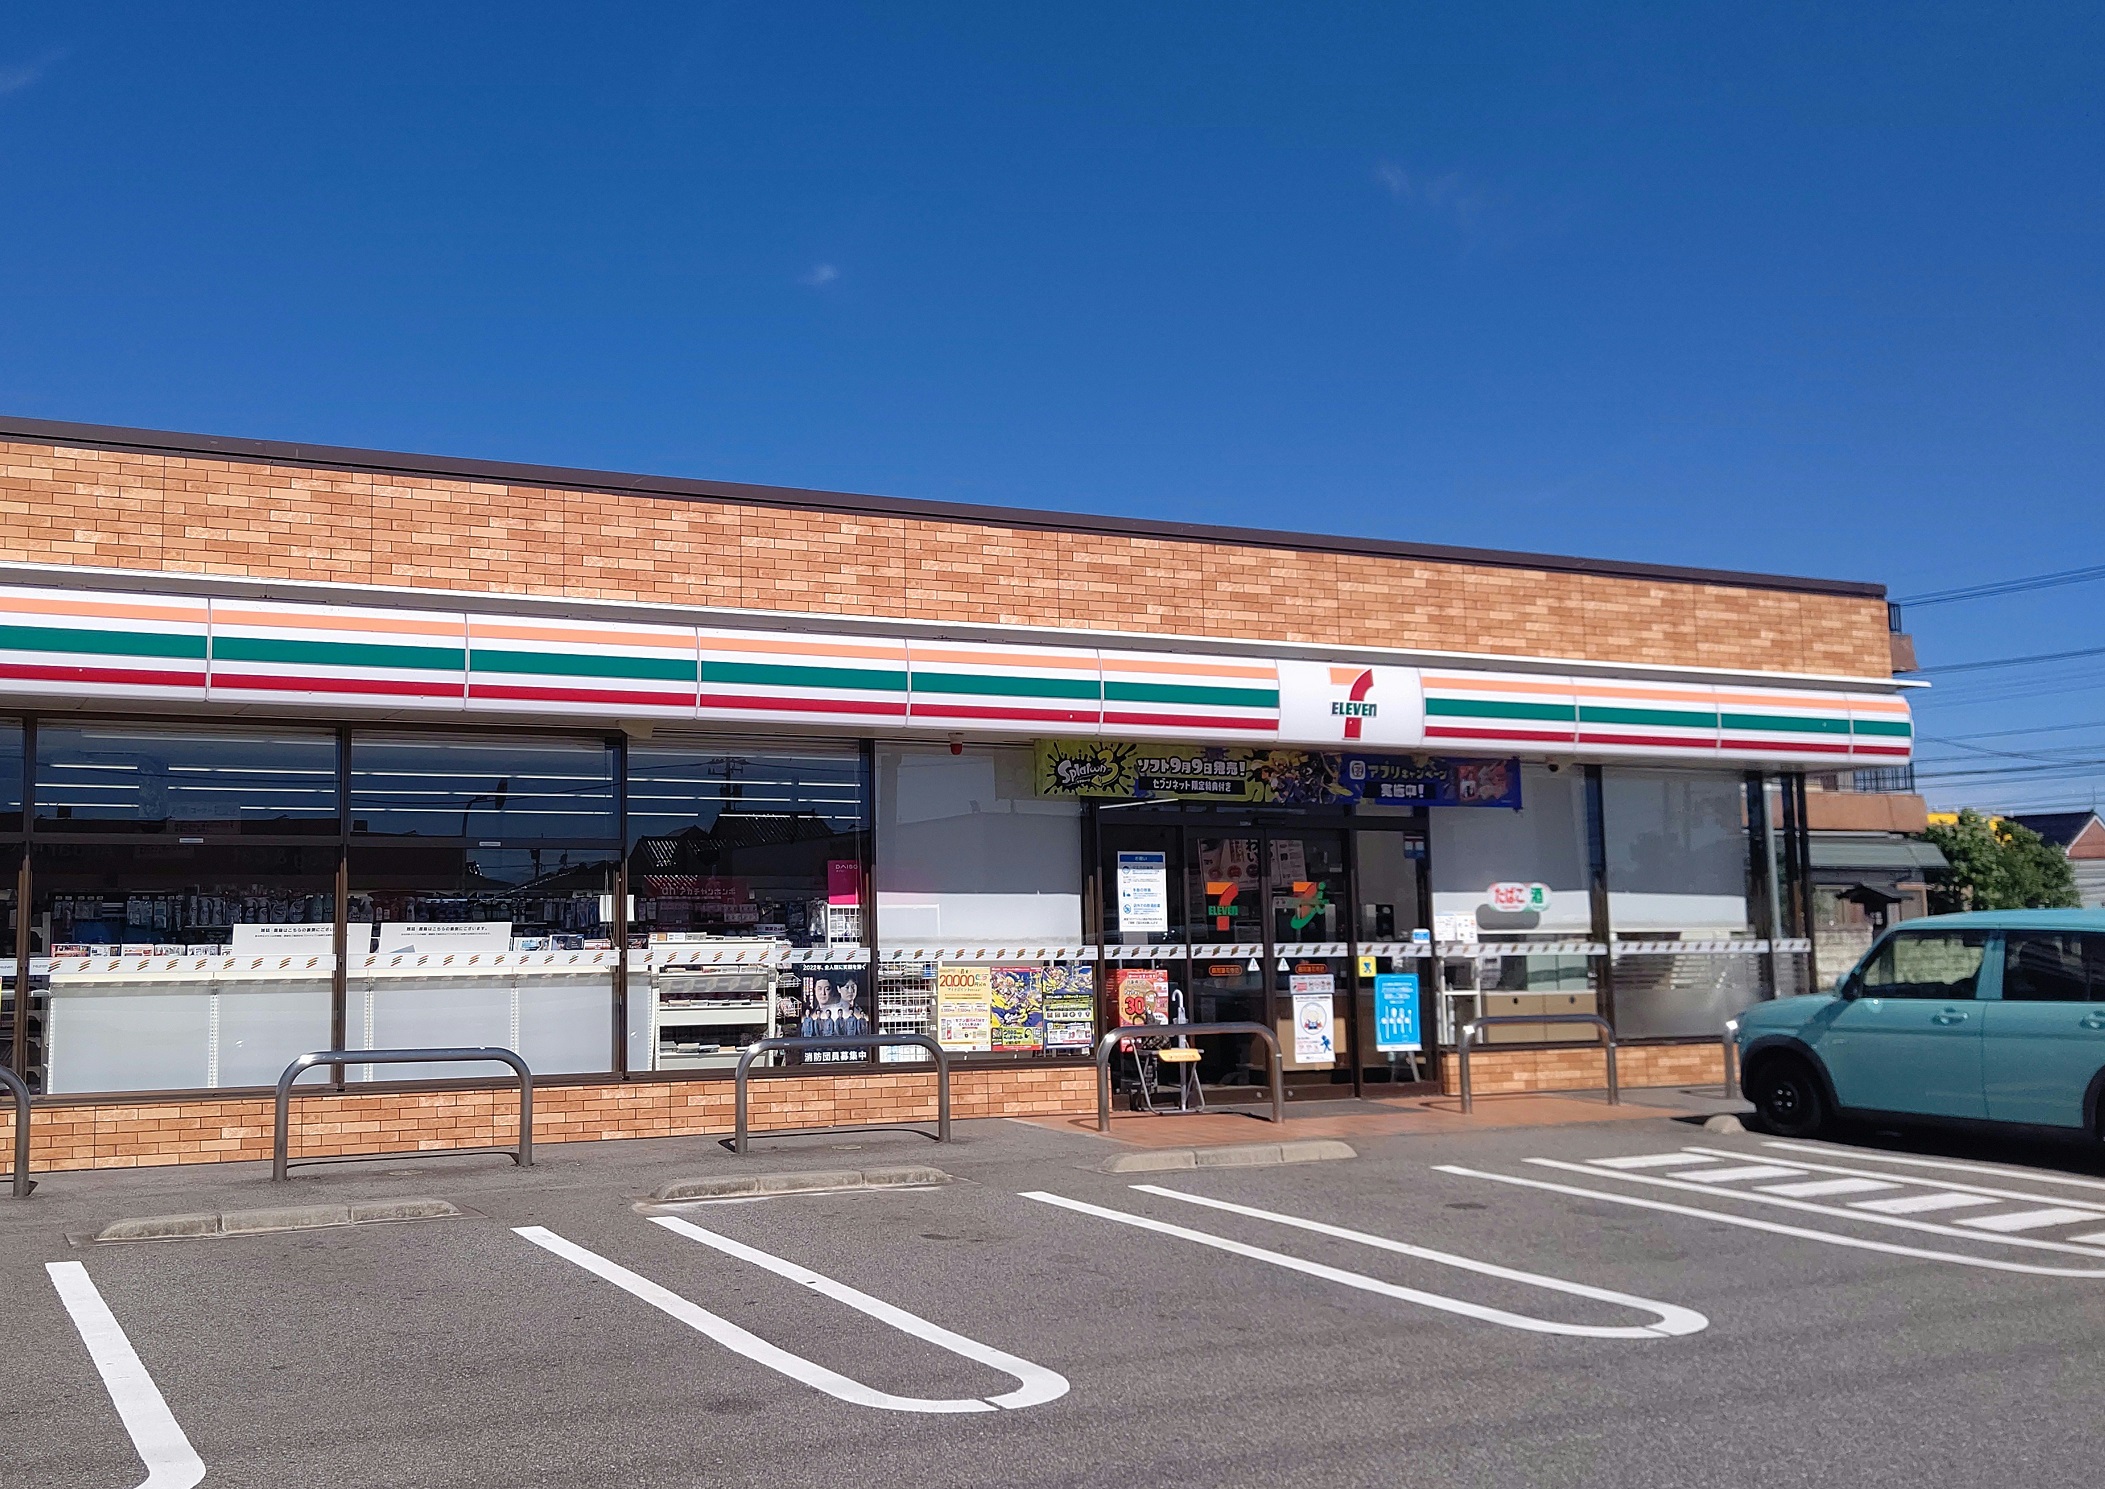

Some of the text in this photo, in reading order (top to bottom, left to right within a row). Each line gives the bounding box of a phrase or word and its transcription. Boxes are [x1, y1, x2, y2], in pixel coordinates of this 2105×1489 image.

[1331, 701, 1377, 717] ELEVEn
[1057, 758, 1106, 783] Splatoon
[1367, 763, 1448, 780] アプリキャンペーン
[1494, 886, 1543, 904] たばこ 酒
[1208, 905, 1238, 916] ELEVEn
[1124, 996, 1145, 1015] 30
[804, 1050, 867, 1063] 消防団員募集中
